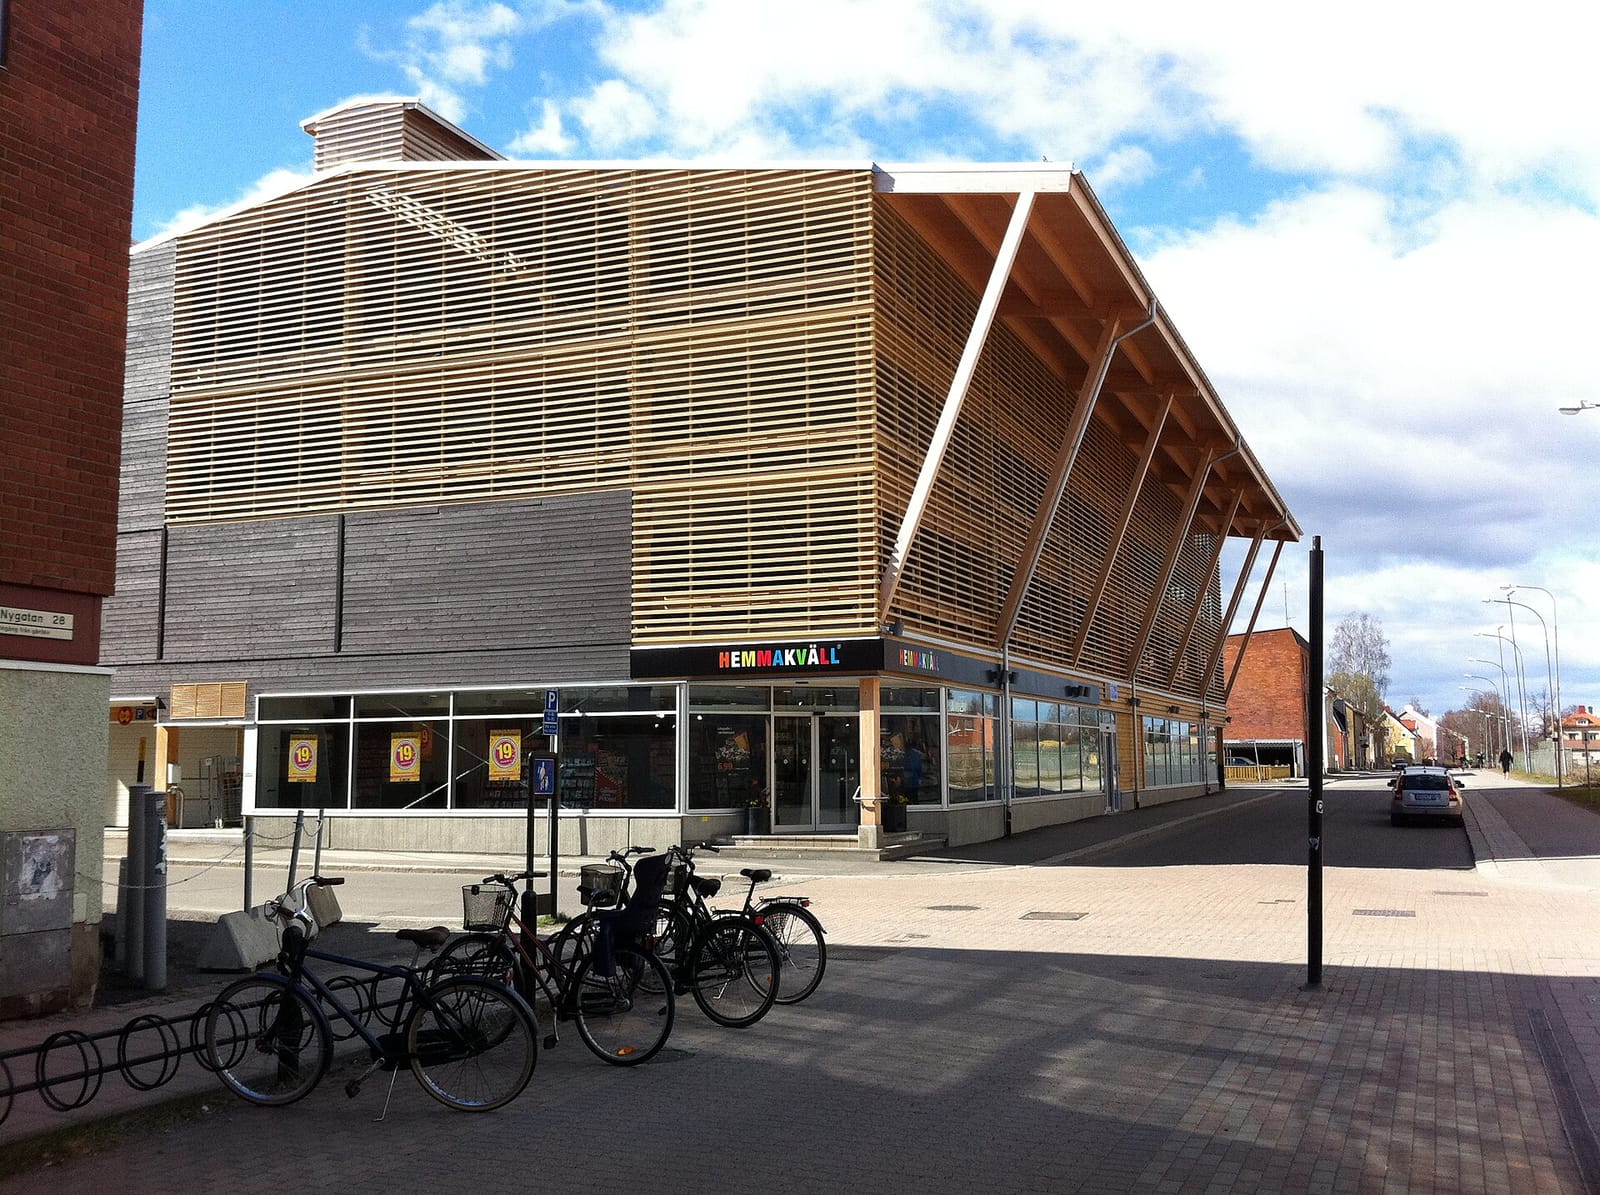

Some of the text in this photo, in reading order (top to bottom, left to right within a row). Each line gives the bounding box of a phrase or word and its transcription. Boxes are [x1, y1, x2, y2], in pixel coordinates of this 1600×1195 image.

[0, 609, 65, 625] Nygatan 28
[719, 644, 840, 668] HEMMAKVÄLL
[899, 649, 940, 671] HEMMAKVÄLL
[548, 691, 556, 709] P
